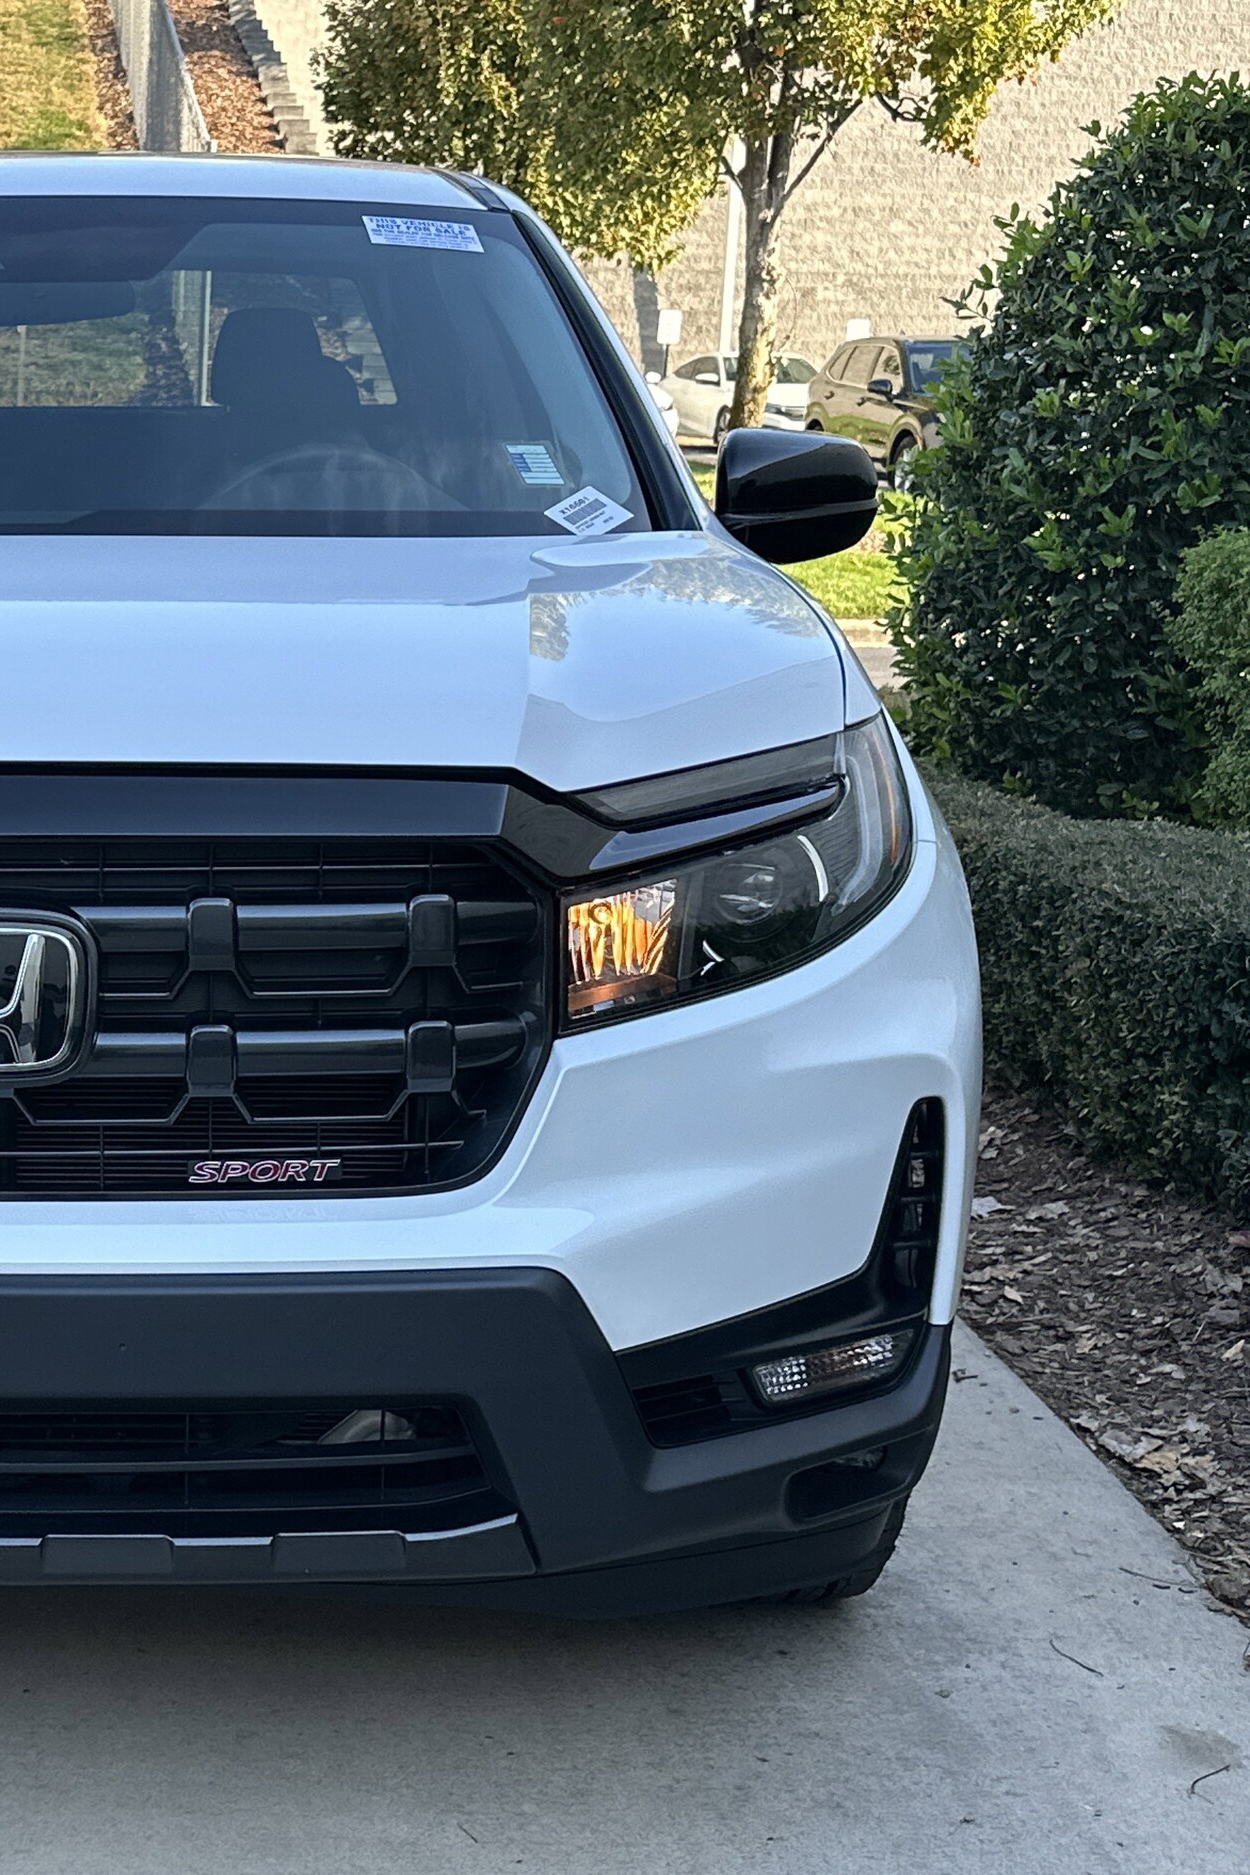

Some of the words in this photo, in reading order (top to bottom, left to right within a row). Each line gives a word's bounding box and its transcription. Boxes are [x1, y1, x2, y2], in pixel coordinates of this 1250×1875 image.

[369, 217, 397, 225] THIS
[401, 219, 454, 230] VEHICLE
[376, 223, 401, 231] NOT
[406, 225, 431, 233] FOR
[435, 227, 466, 237] SALE
[188, 1158, 341, 1183] SPORT
